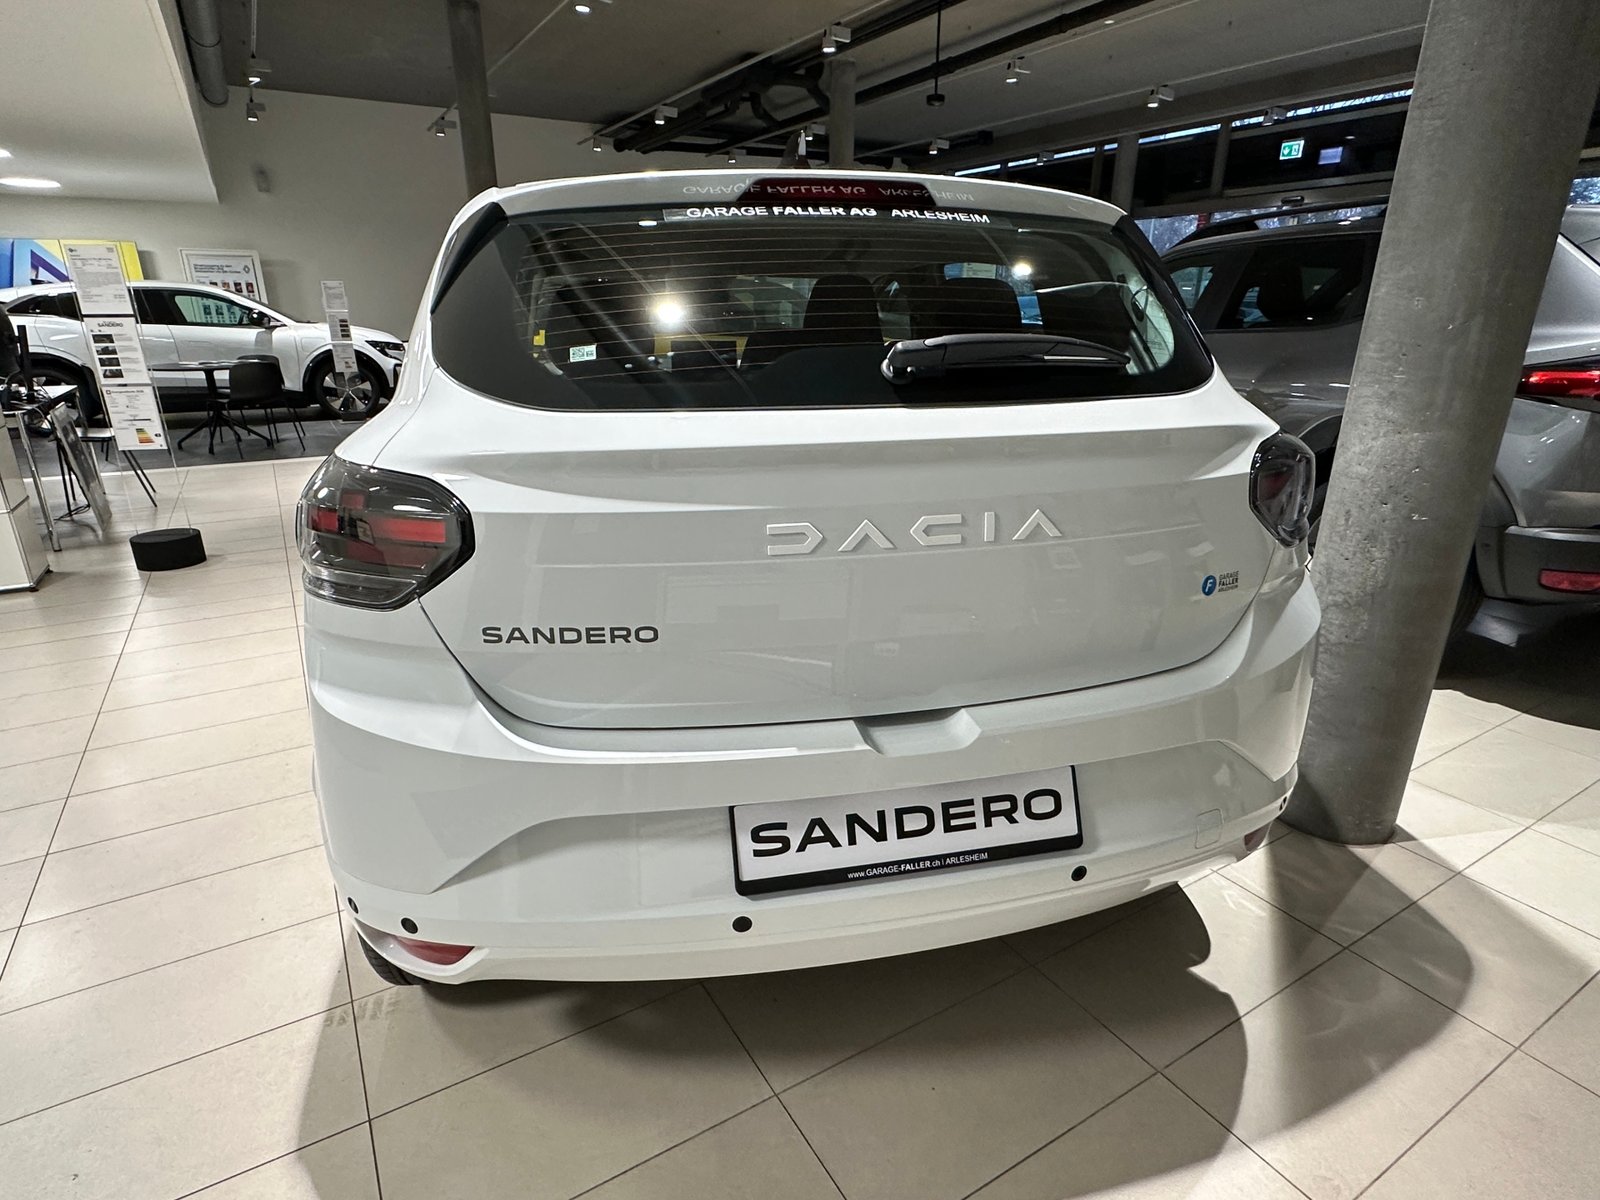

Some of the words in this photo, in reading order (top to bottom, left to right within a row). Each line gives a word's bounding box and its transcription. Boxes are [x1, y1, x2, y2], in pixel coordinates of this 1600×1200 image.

[686, 206, 769, 218] GARAGE
[772, 206, 846, 216] FALLER
[849, 207, 877, 217] AG
[891, 209, 990, 223] ARLESHEIM
[766, 508, 1063, 556] DACIA
[1218, 578, 1239, 587] FALLER
[481, 625, 659, 645] SANDERO
[750, 788, 1063, 858] SANDERO
[847, 860, 941, 879] www.GARAGE-FALLER.ch
[945, 852, 989, 865] ARLESHEIM
